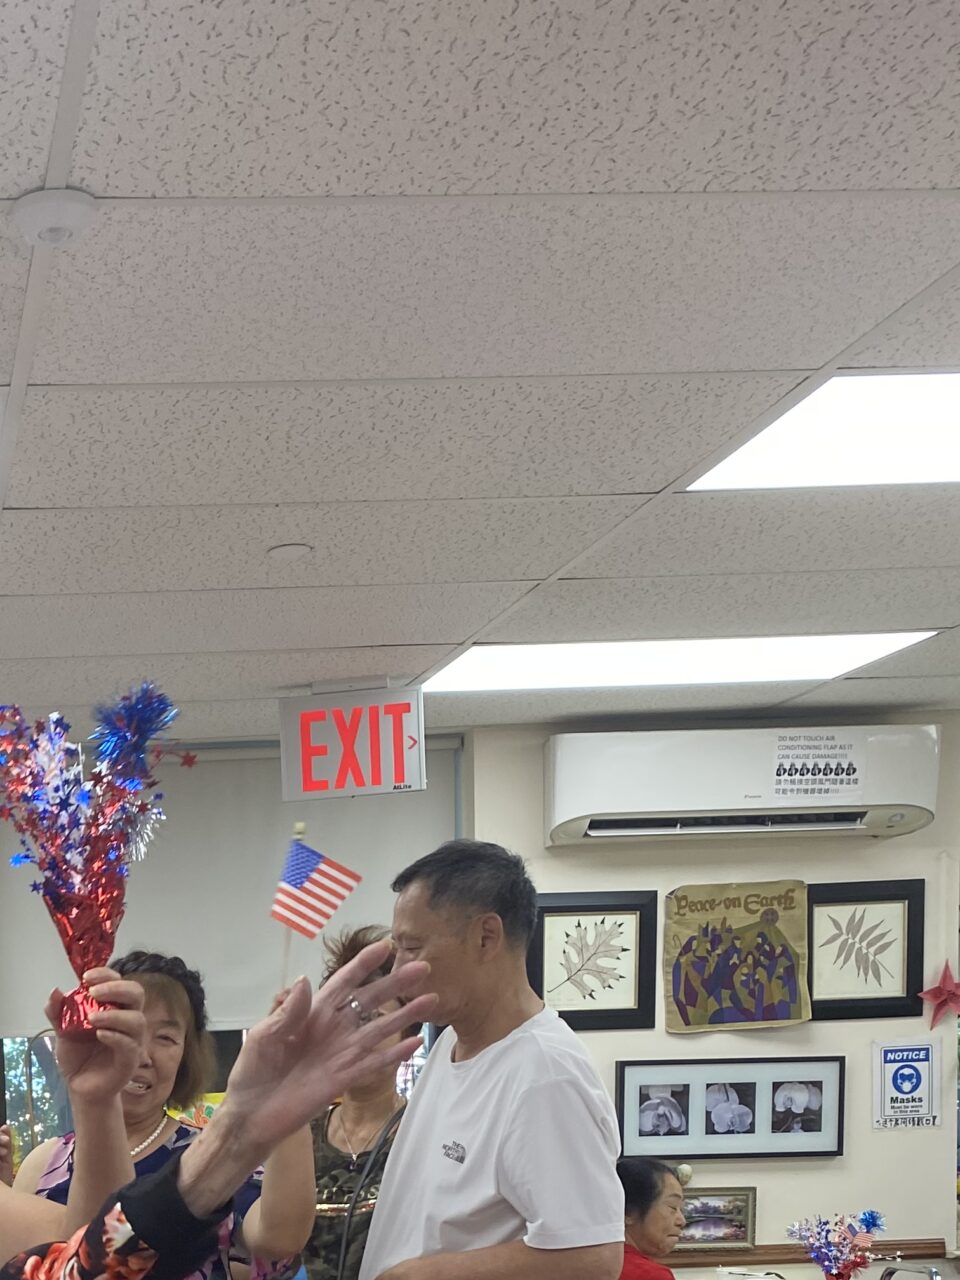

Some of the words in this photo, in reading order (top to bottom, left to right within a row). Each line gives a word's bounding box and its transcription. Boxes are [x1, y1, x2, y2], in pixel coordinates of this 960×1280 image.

[299, 702, 411, 792] EXIT
[673, 894, 717, 917] Peace
[724, 896, 742, 910] on
[743, 888, 796, 915] Earth
[887, 1051, 926, 1060] NOTICE
[890, 1096, 923, 1104] Masks
